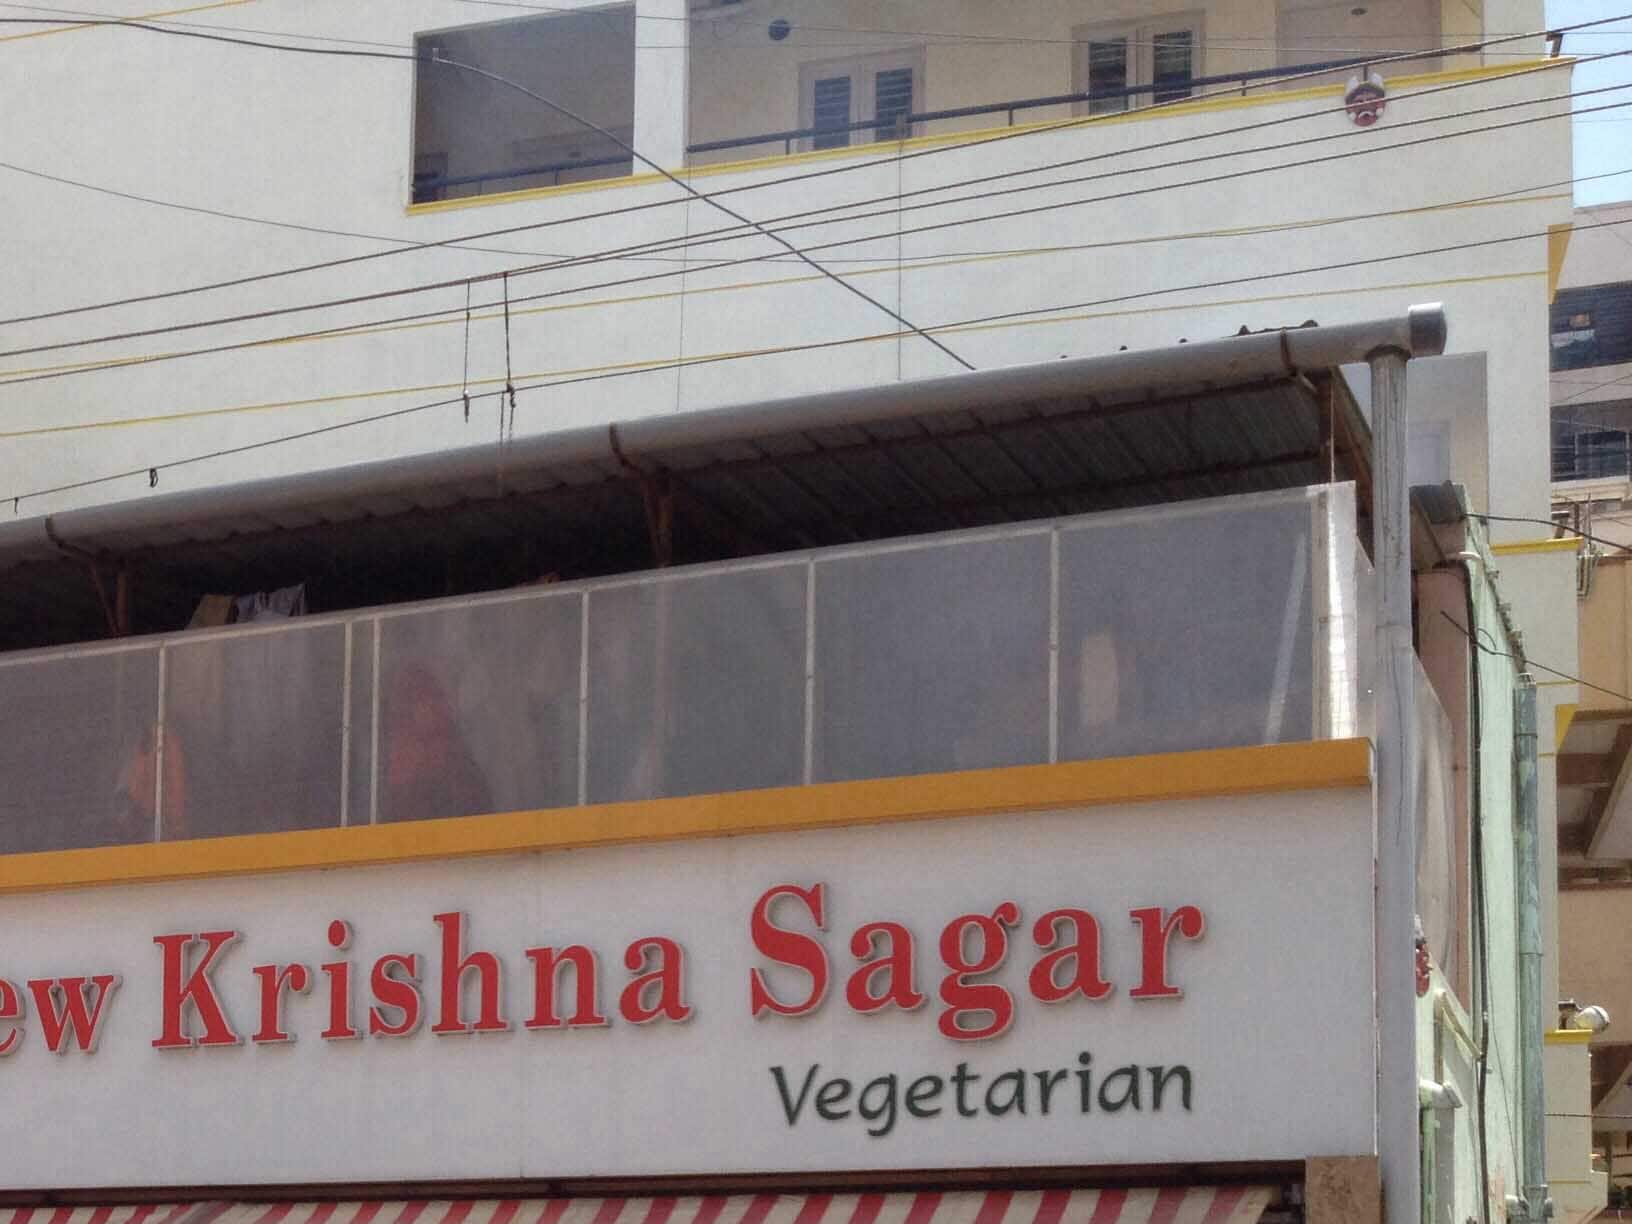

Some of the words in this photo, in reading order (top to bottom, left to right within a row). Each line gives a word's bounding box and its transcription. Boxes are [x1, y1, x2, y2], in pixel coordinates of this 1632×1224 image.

[152, 911, 692, 1050] Krishna
[749, 882, 1206, 1041] Sagar
[770, 1051, 1194, 1137] Vegetarian
